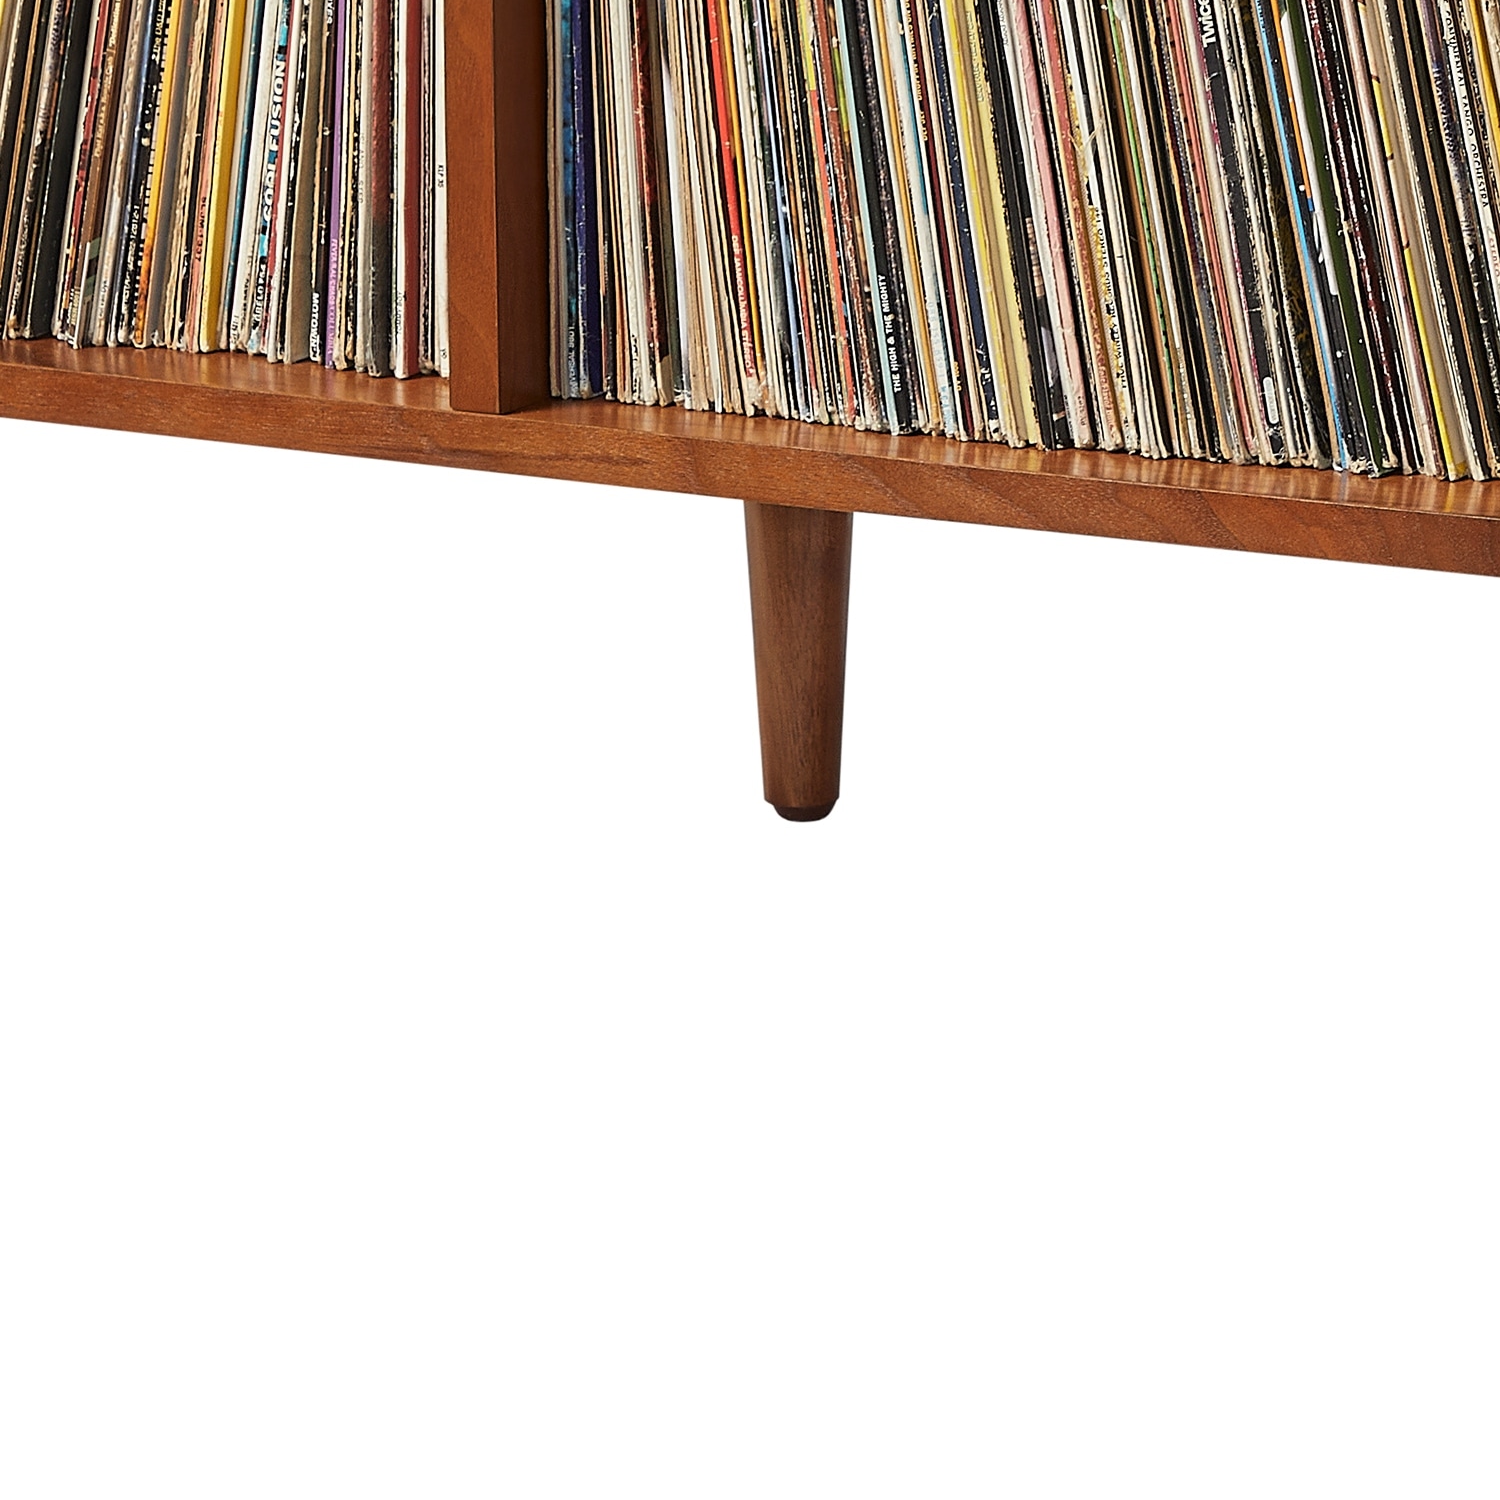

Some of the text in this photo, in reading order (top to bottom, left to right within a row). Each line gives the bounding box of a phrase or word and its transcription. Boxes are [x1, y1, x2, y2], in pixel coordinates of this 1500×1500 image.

[267, 59, 285, 151] FUSION
[309, 292, 319, 348] MOTOWN
[877, 273, 902, 392] THE HIGH & THE MIGHTY
